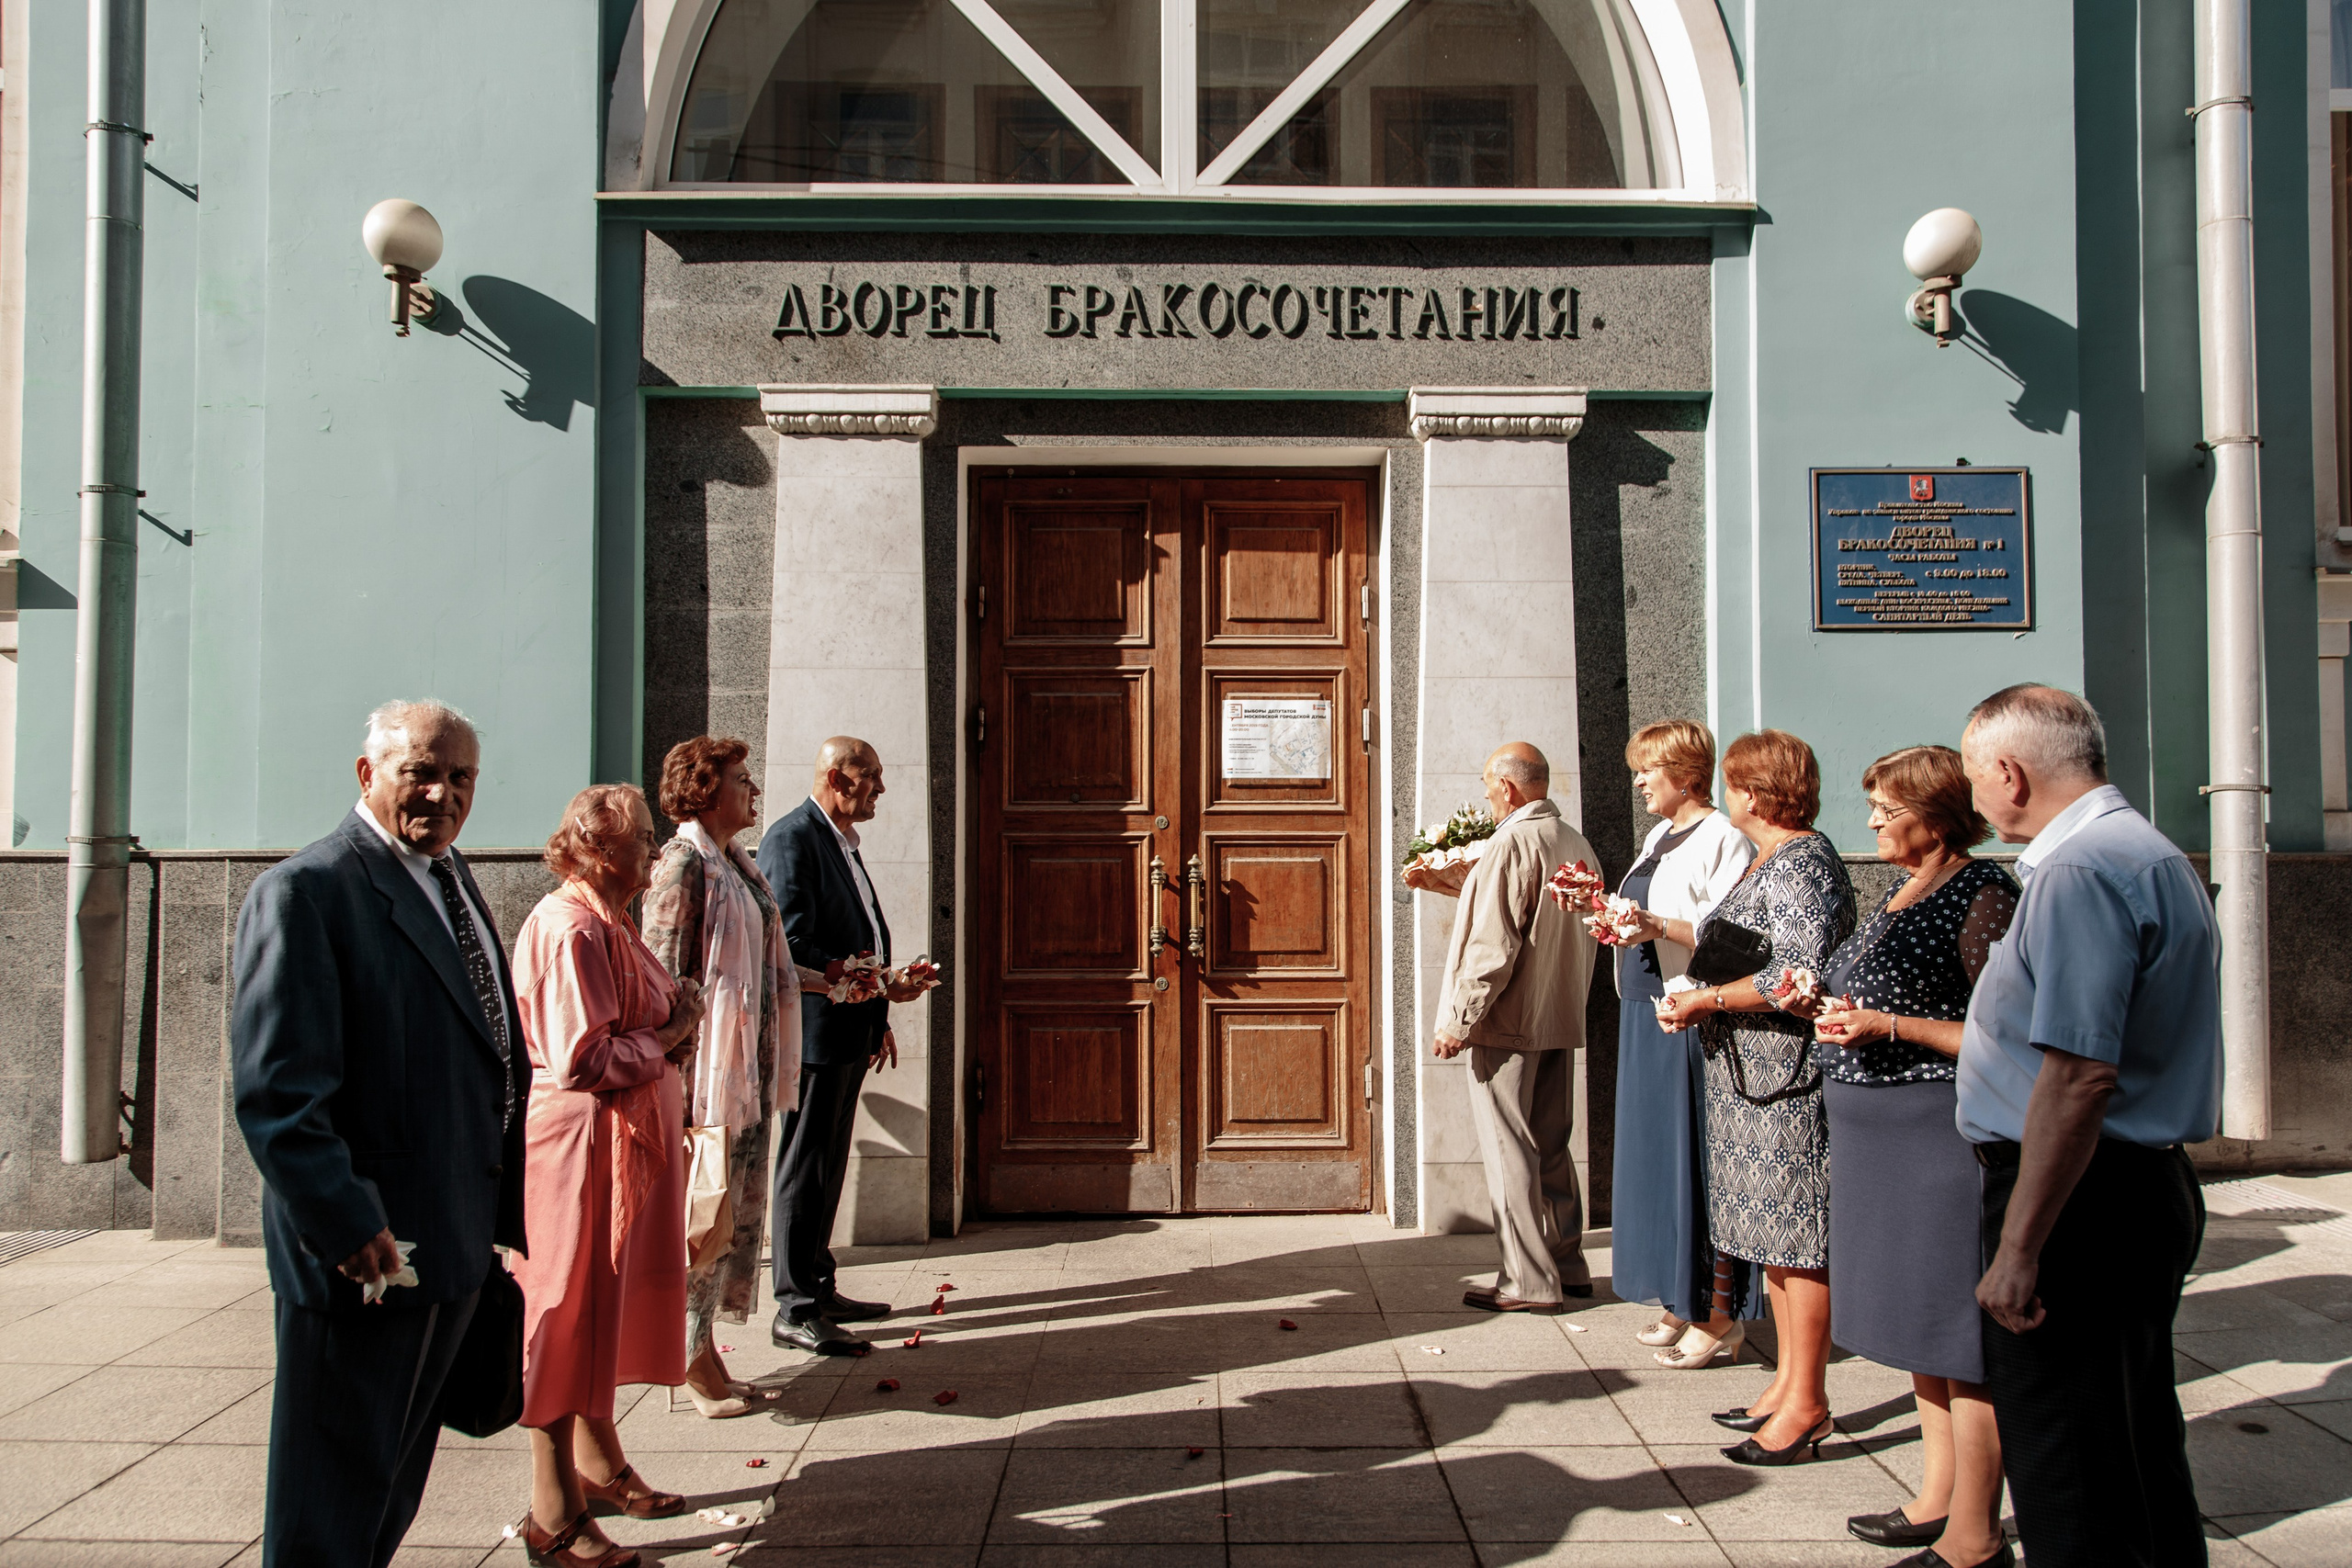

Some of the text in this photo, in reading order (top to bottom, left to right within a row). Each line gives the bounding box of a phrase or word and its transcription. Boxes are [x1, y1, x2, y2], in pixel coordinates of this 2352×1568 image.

[772, 280, 1580, 344] ДВОРЕЦ БРАКОСОЧЕТАНИЯ
[1891, 526, 1953, 539] ДВОРЕЦ
[1838, 538, 1976, 550] БРАКОСОЧЕТАНИЯ
[1888, 553, 1957, 561] ЧАСЫ РАБОТЫ
[1959, 570, 1973, 580] до
[1977, 569, 2007, 578] 18.00
[1944, 613, 1973, 622] ДЕНЬ
